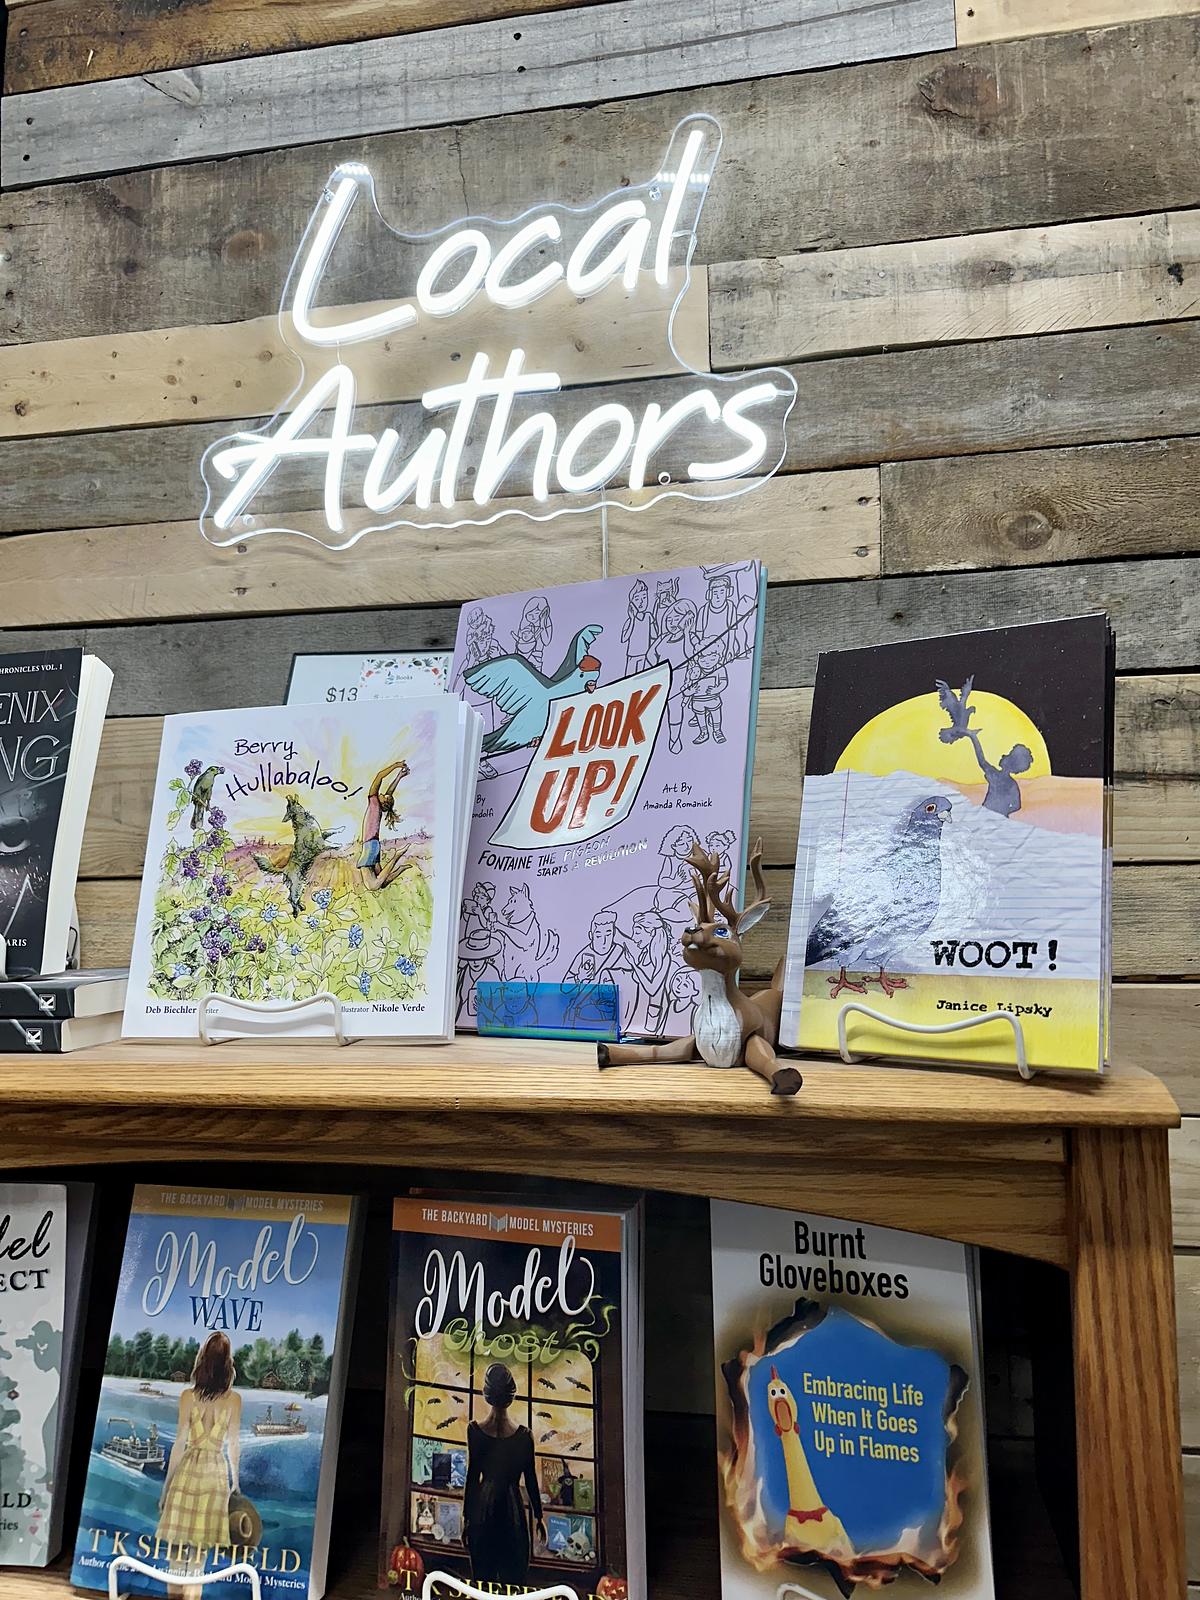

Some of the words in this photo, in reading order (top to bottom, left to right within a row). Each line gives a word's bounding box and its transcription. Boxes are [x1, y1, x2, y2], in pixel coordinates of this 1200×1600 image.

[292, 129, 704, 346] Local
[211, 348, 778, 531] Authors
[41, 663, 58, 671] VOL.
[326, 686, 358, 702] $13
[544, 683, 663, 760] LOOK
[234, 738, 298, 760] Berry
[225, 760, 363, 801] Hullabaloo!
[530, 755, 639, 834] UP!
[662, 783, 678, 793] Art
[681, 782, 692, 795] By
[476, 794, 486, 806] By
[643, 799, 673, 810] Amanda
[675, 797, 713, 808] Romanick
[478, 850, 533, 871] FONTAINE
[538, 852, 557, 867] THE
[564, 835, 610, 862] PIGEON
[536, 864, 569, 877] STARTS
[584, 838, 648, 868] REVOLUTION
[930, 939, 1058, 971] WOOT!
[145, 1005, 161, 1014] Deb
[164, 1005, 197, 1014] Biechler
[372, 1004, 399, 1013] Nikole
[402, 1003, 425, 1012] Verde
[937, 1000, 988, 1012] Janice
[997, 1003, 1053, 1018] Lipsky
[160, 1193, 177, 1204] THE
[179, 1193, 225, 1206] BACKYARD
[246, 1197, 275, 1209] MODEL
[277, 1199, 324, 1212] MYSTERIES
[422, 1208, 439, 1221] THE
[441, 1211, 488, 1226] BACKYARD
[509, 1216, 540, 1232] MODEL
[542, 1220, 594, 1236] MYSTERIES
[794, 1220, 867, 1259] Burnt
[142, 1213, 319, 1327] Model
[759, 1253, 909, 1299] Gloveboxes
[415, 1235, 595, 1350] Model
[189, 1294, 263, 1332] WAVE
[443, 1317, 561, 1364] Ghost
[803, 1372, 888, 1408] Embracing
[892, 1382, 924, 1406] Life
[812, 1401, 856, 1427] When
[861, 1407, 873, 1429] It
[876, 1409, 918, 1434] Goes
[814, 1429, 835, 1458] Up
[840, 1433, 855, 1455] in
[859, 1435, 920, 1463] Flames
[89, 1528, 107, 1552] T
[111, 1531, 130, 1556] K
[136, 1534, 301, 1573] SHEFFIELD
[79, 1555, 105, 1568] Author
[264, 1575, 306, 1589] Mysteries
